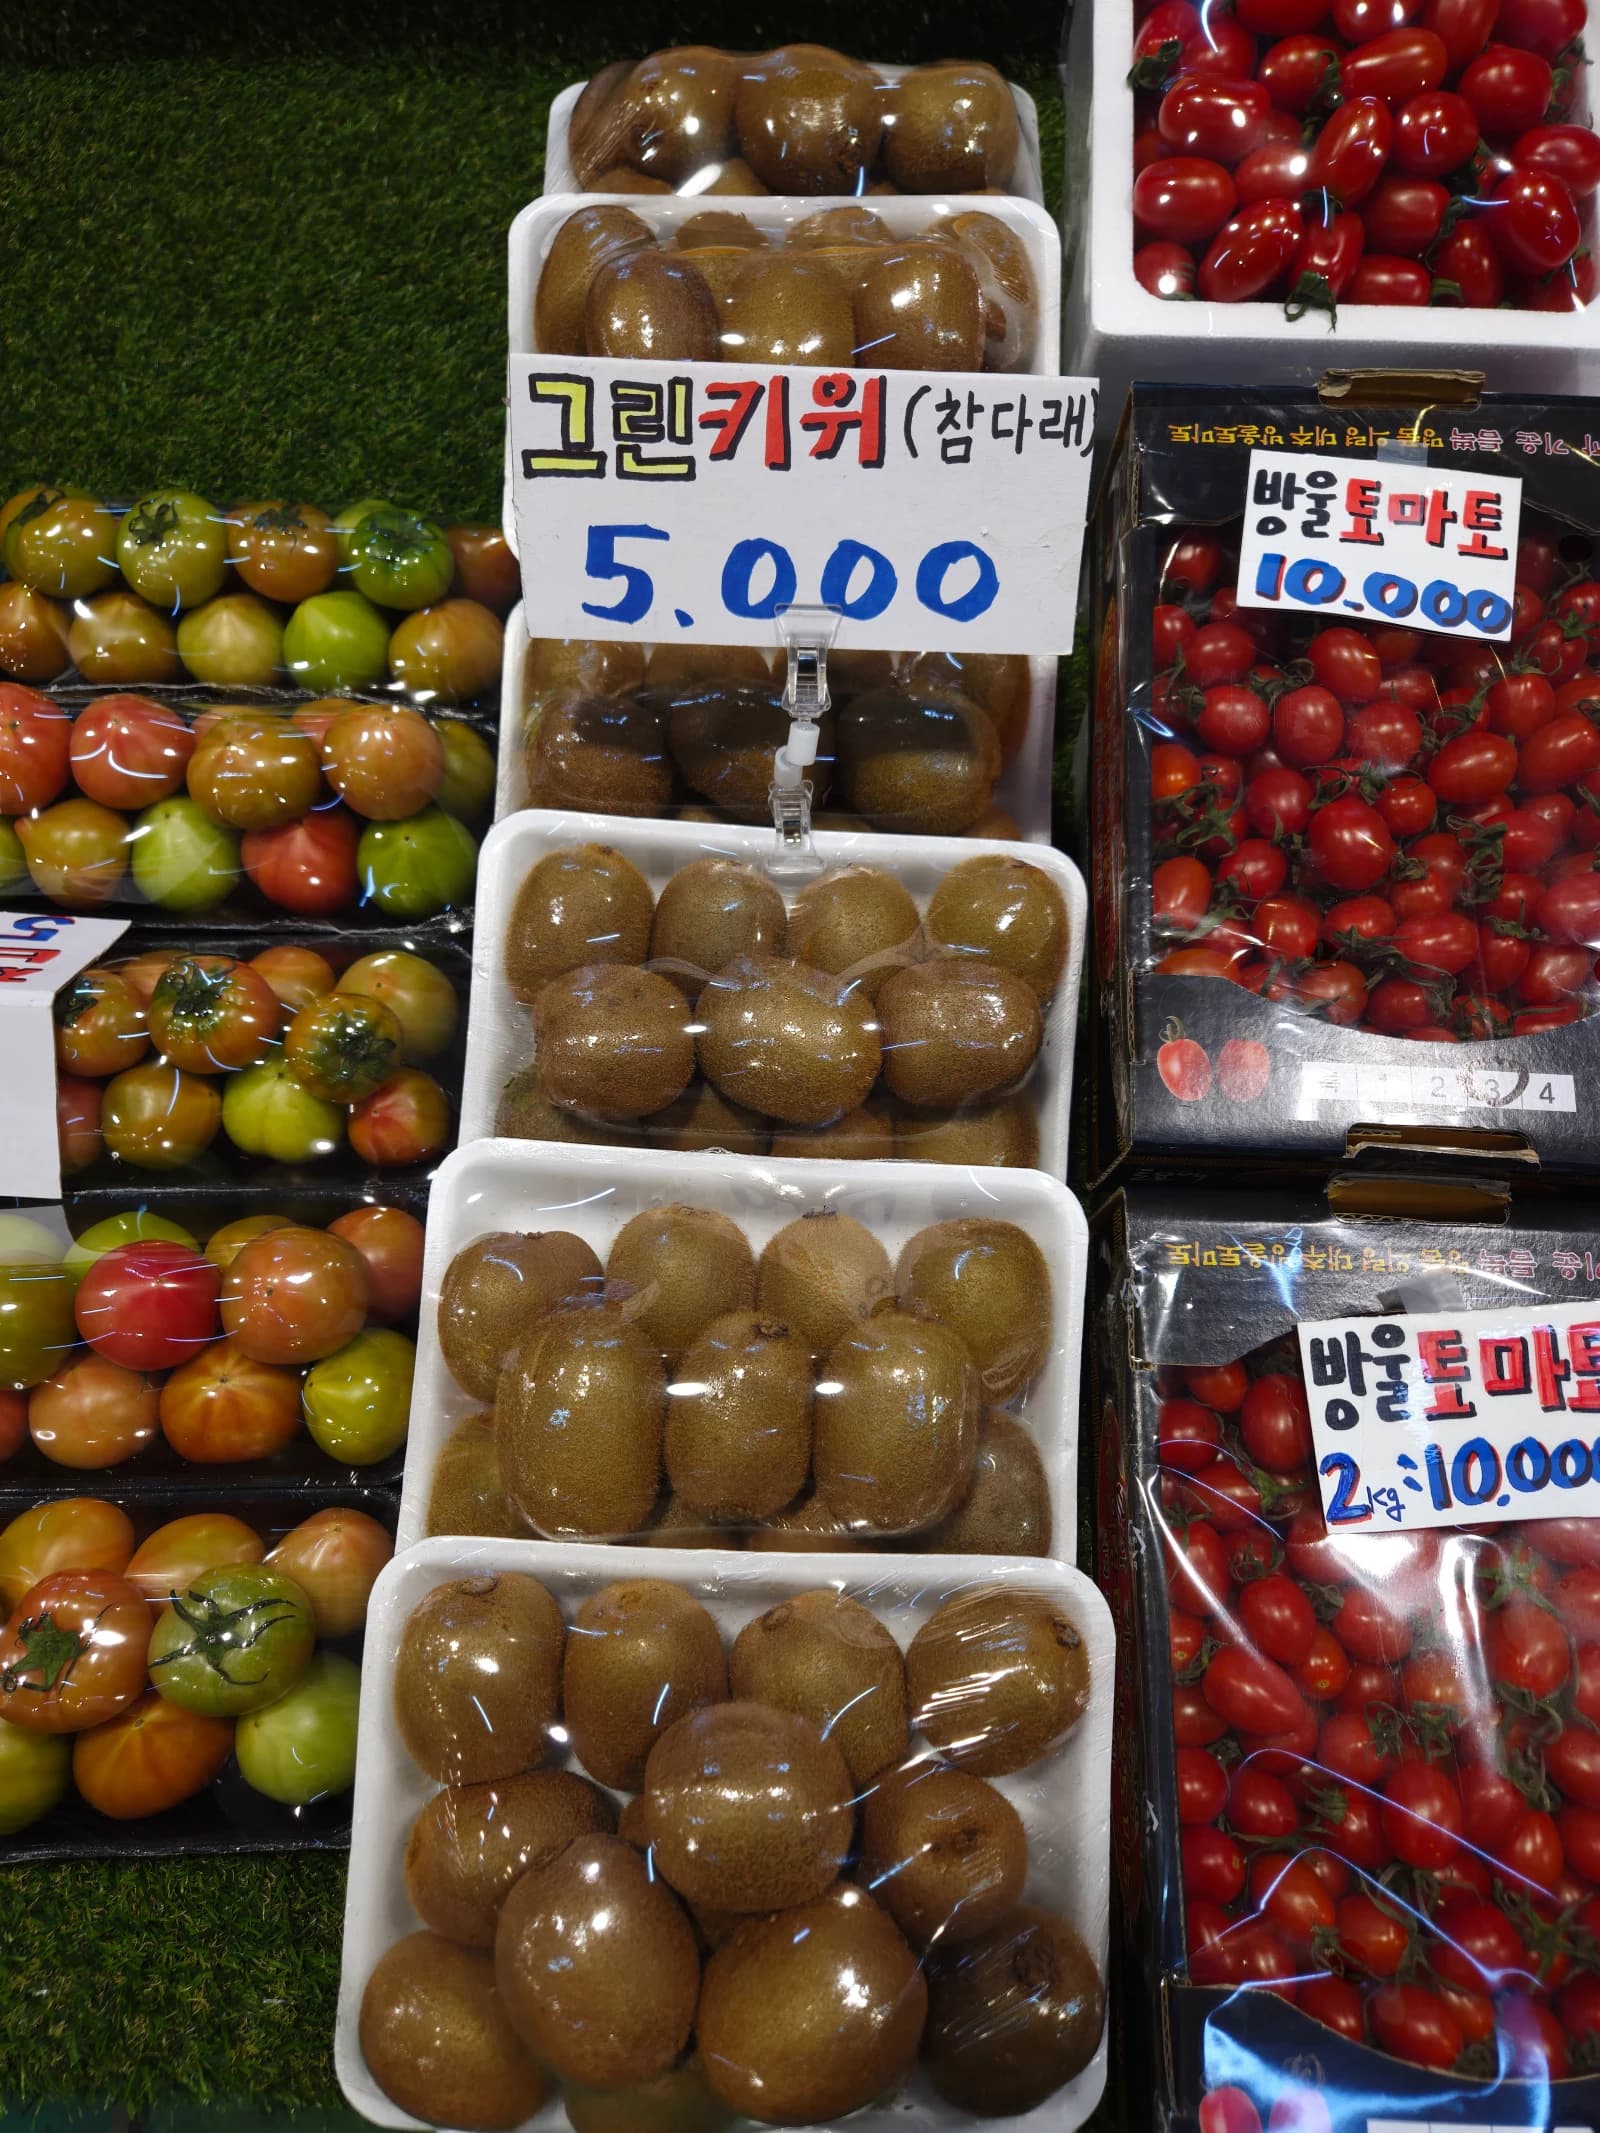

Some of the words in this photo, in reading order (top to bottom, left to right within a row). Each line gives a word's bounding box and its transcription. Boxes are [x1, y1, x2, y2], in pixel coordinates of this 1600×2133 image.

[523, 372, 887, 481] 그린키위
[1168, 422, 1285, 447] 방울토마토
[1289, 424, 1337, 448] 대추
[1345, 425, 1390, 448] 의령
[1450, 427, 1503, 453] 듬뿍
[1516, 431, 1569, 456] 기운
[1253, 469, 1508, 560] 방울토마토
[581, 524, 1000, 627] 5.000
[1256, 553, 1513, 634] 10.000
[1431, 1075, 1446, 1098] 2
[1485, 1078, 1501, 1101] 3
[1539, 1081, 1555, 1104] 4
[1302, 1244, 1352, 1272] 대추
